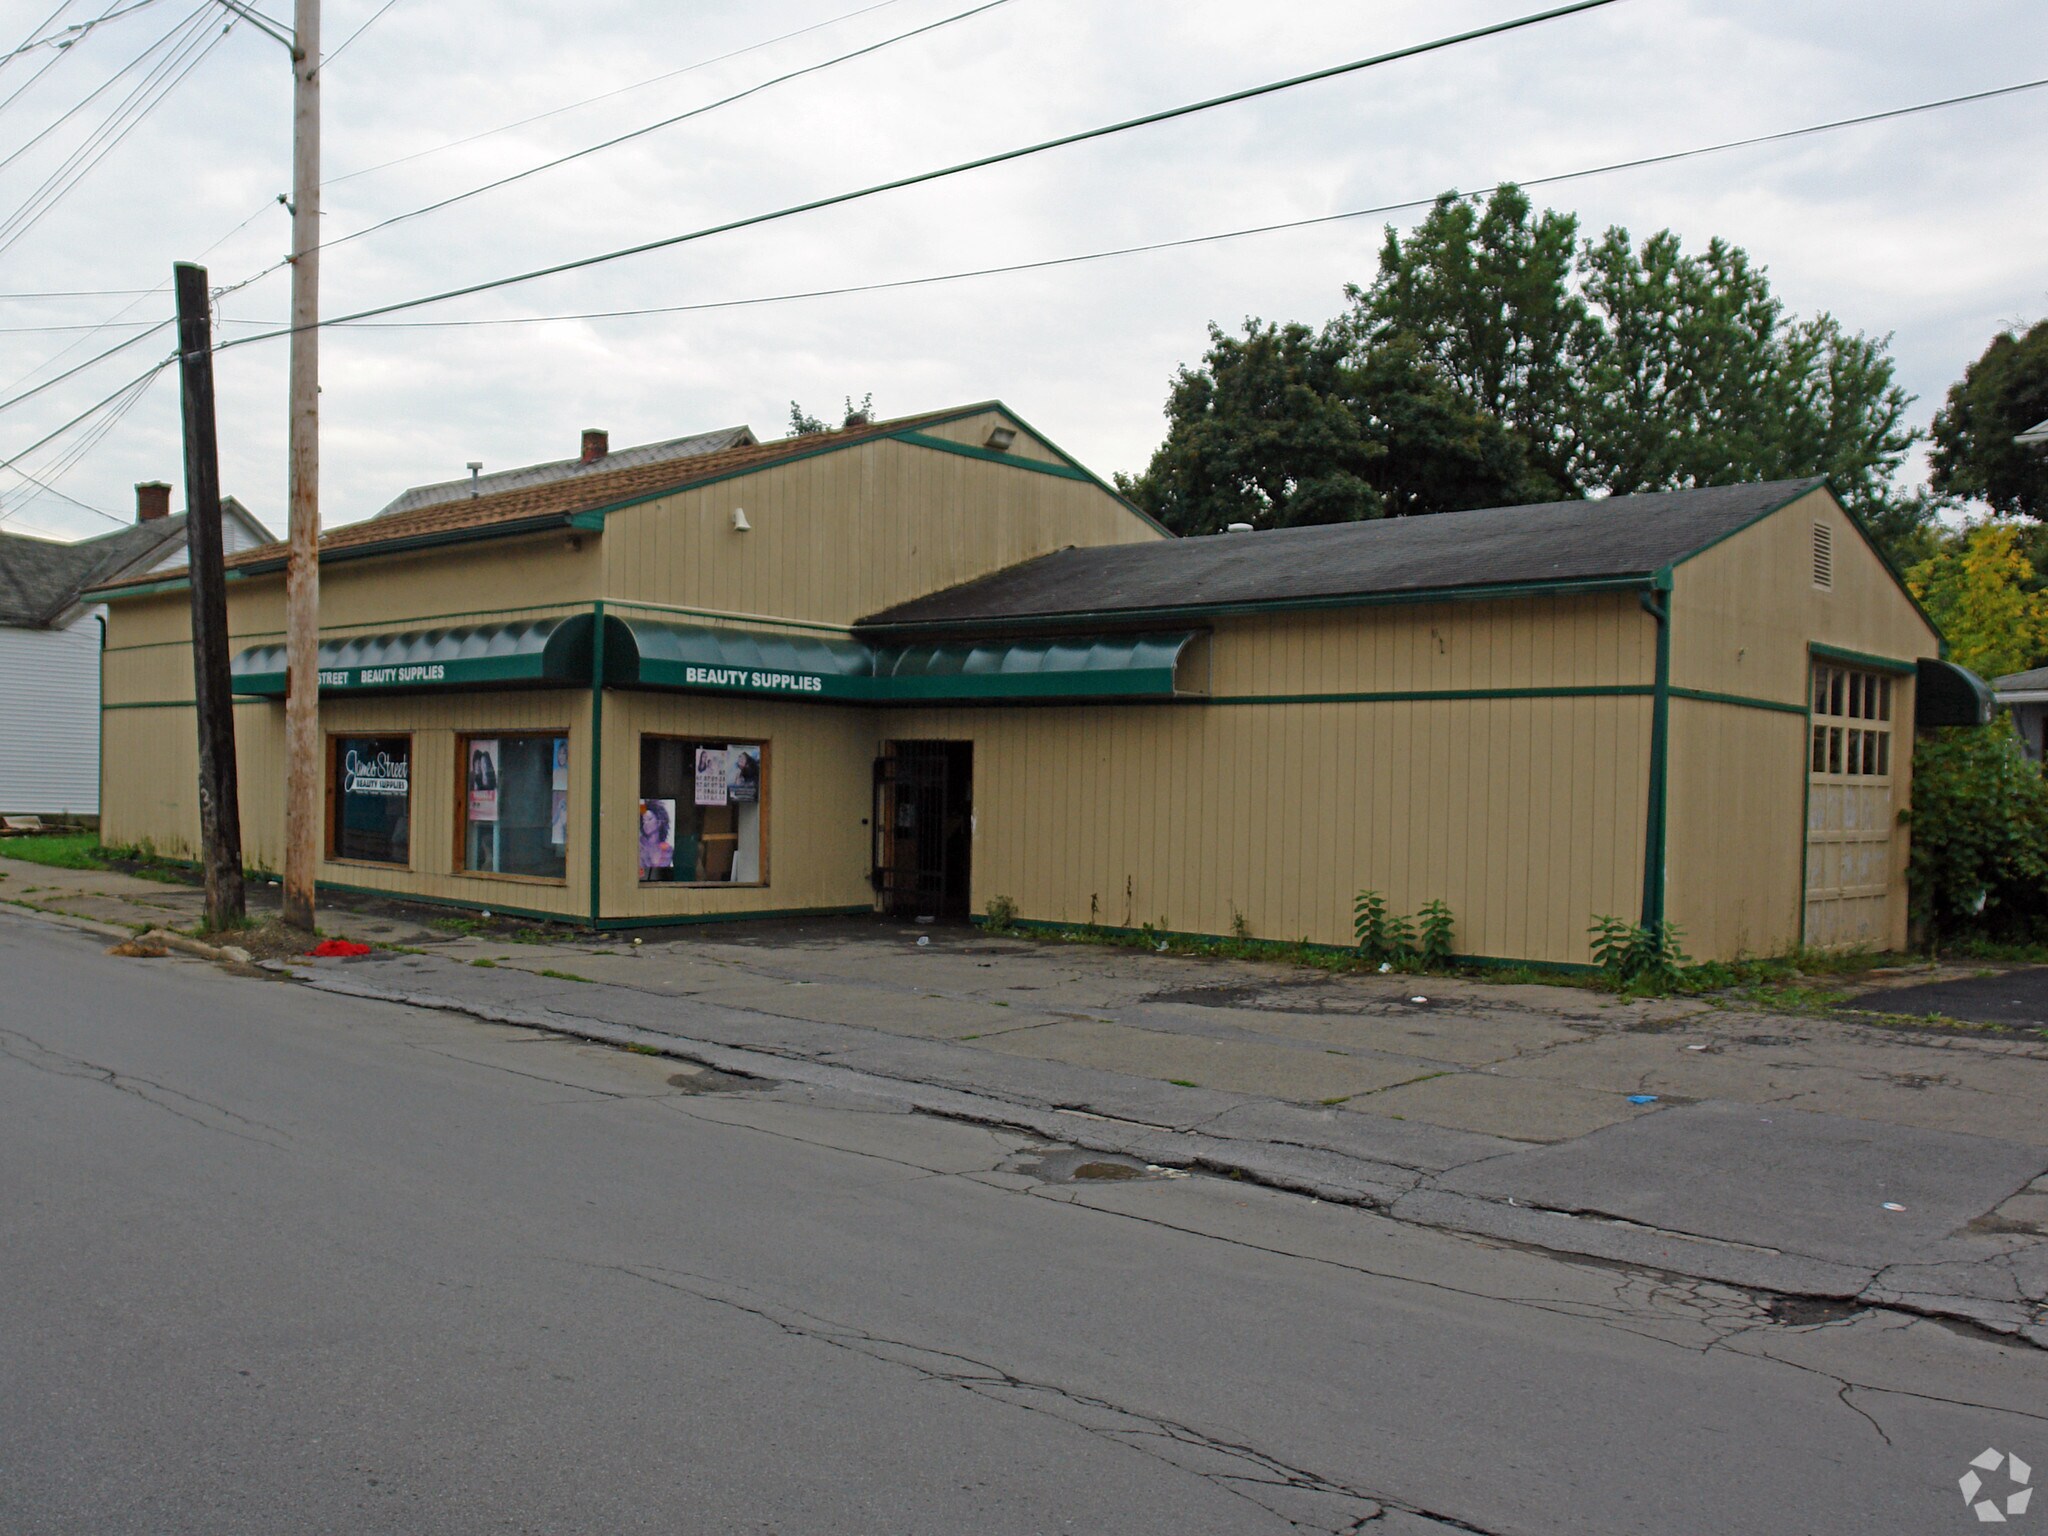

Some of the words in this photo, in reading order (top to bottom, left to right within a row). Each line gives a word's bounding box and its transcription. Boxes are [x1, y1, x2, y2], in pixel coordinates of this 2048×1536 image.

[360, 668, 397, 683] BEAUTY
[398, 665, 445, 681] SUPPLIES
[686, 667, 748, 686] BEAUTY
[751, 672, 822, 691] SUPPLIES
[345, 750, 377, 792] James
[377, 751, 408, 778] Street
[356, 780, 378, 788] BEAUTY
[379, 780, 405, 790] SUPPLIES
